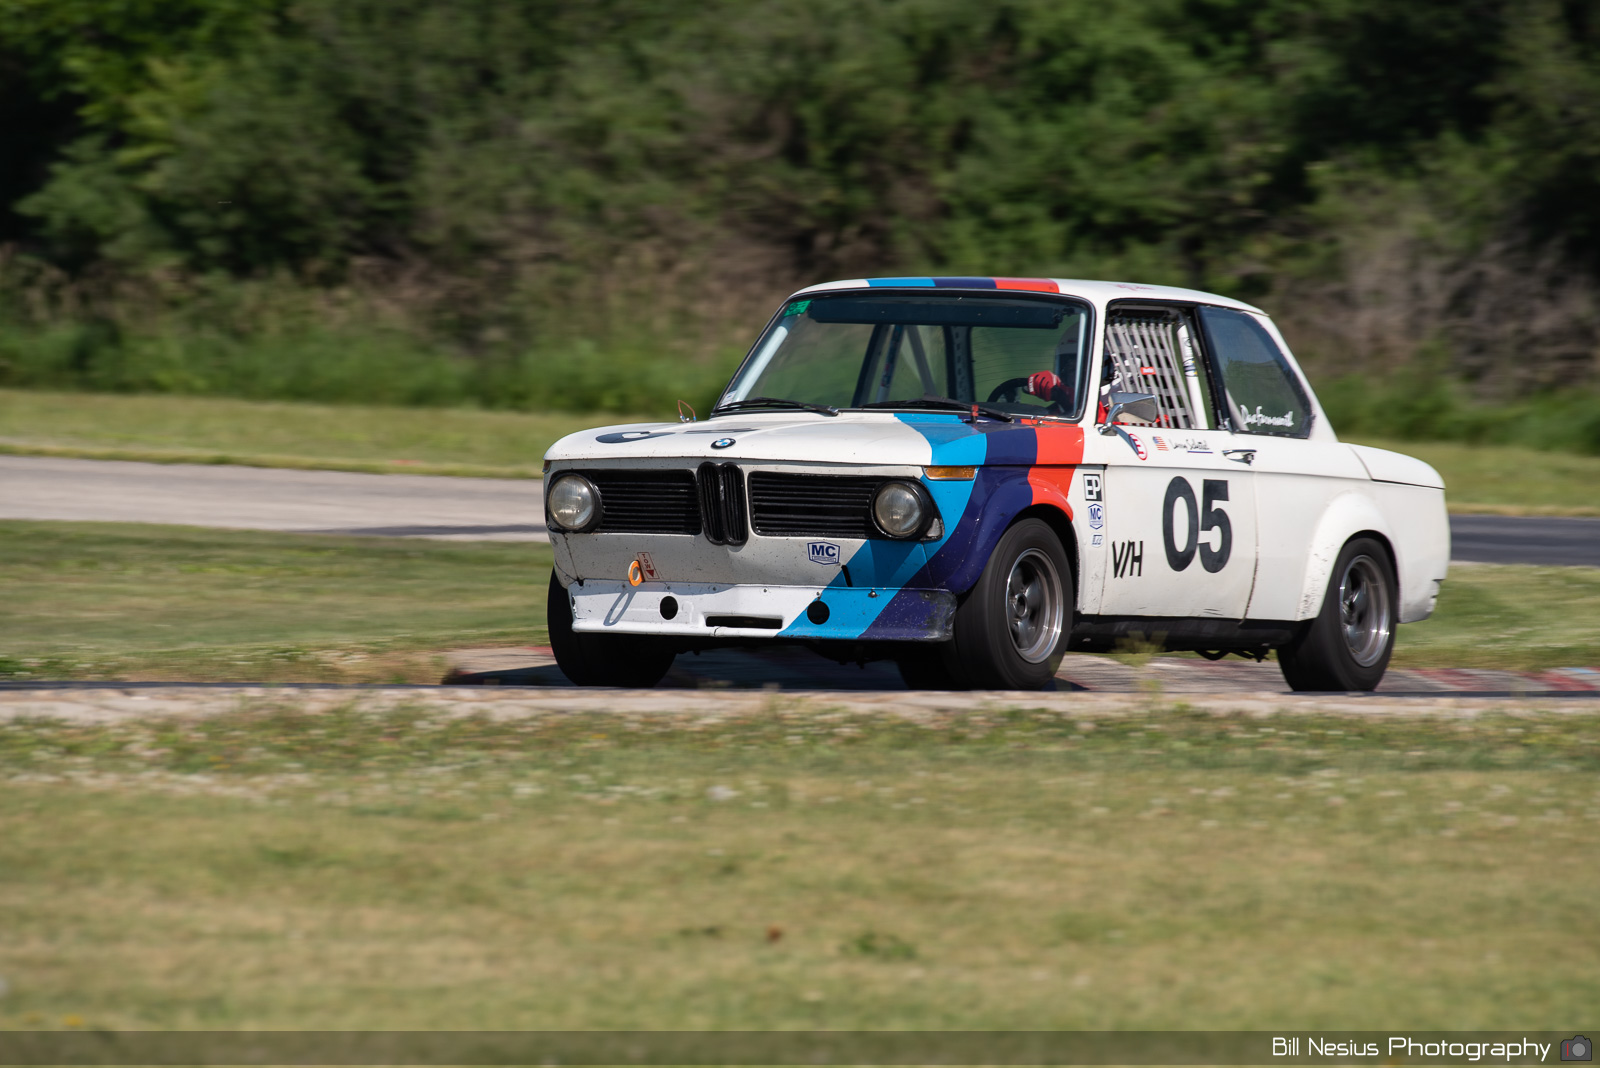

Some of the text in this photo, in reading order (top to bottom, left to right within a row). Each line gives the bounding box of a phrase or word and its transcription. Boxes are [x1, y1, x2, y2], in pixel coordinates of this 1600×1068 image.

[1084, 475, 1101, 500] EP
[1090, 507, 1102, 520] MC
[1162, 475, 1233, 574] 05
[811, 544, 837, 557] MC
[641, 553, 651, 569] TOW
